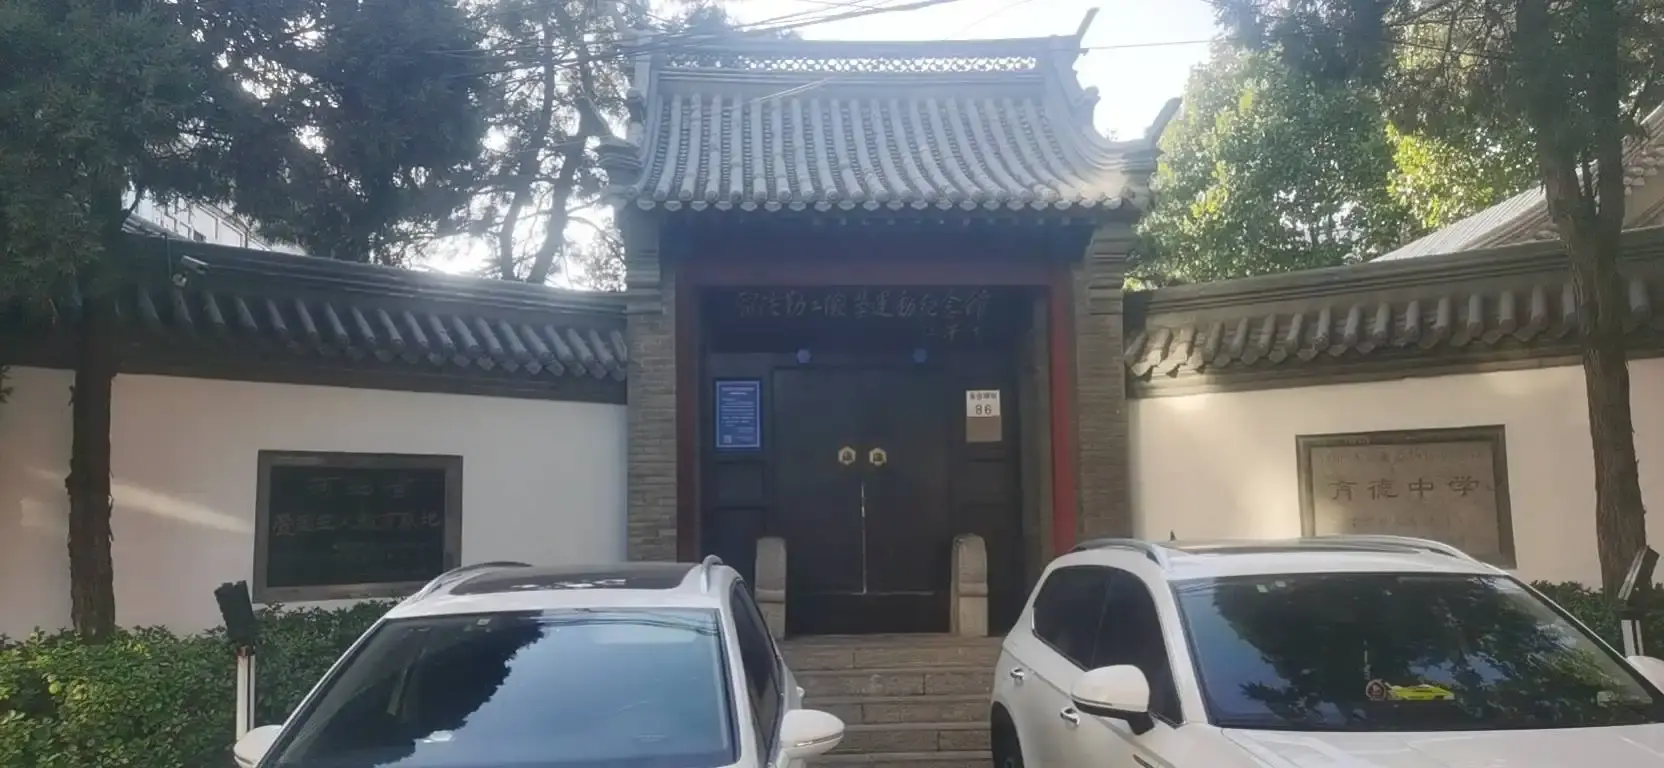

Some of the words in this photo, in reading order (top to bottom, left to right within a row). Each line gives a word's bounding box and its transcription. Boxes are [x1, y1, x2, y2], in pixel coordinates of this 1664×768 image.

[975, 404, 992, 416] 86
[1327, 474, 1480, 501] 育德中学
